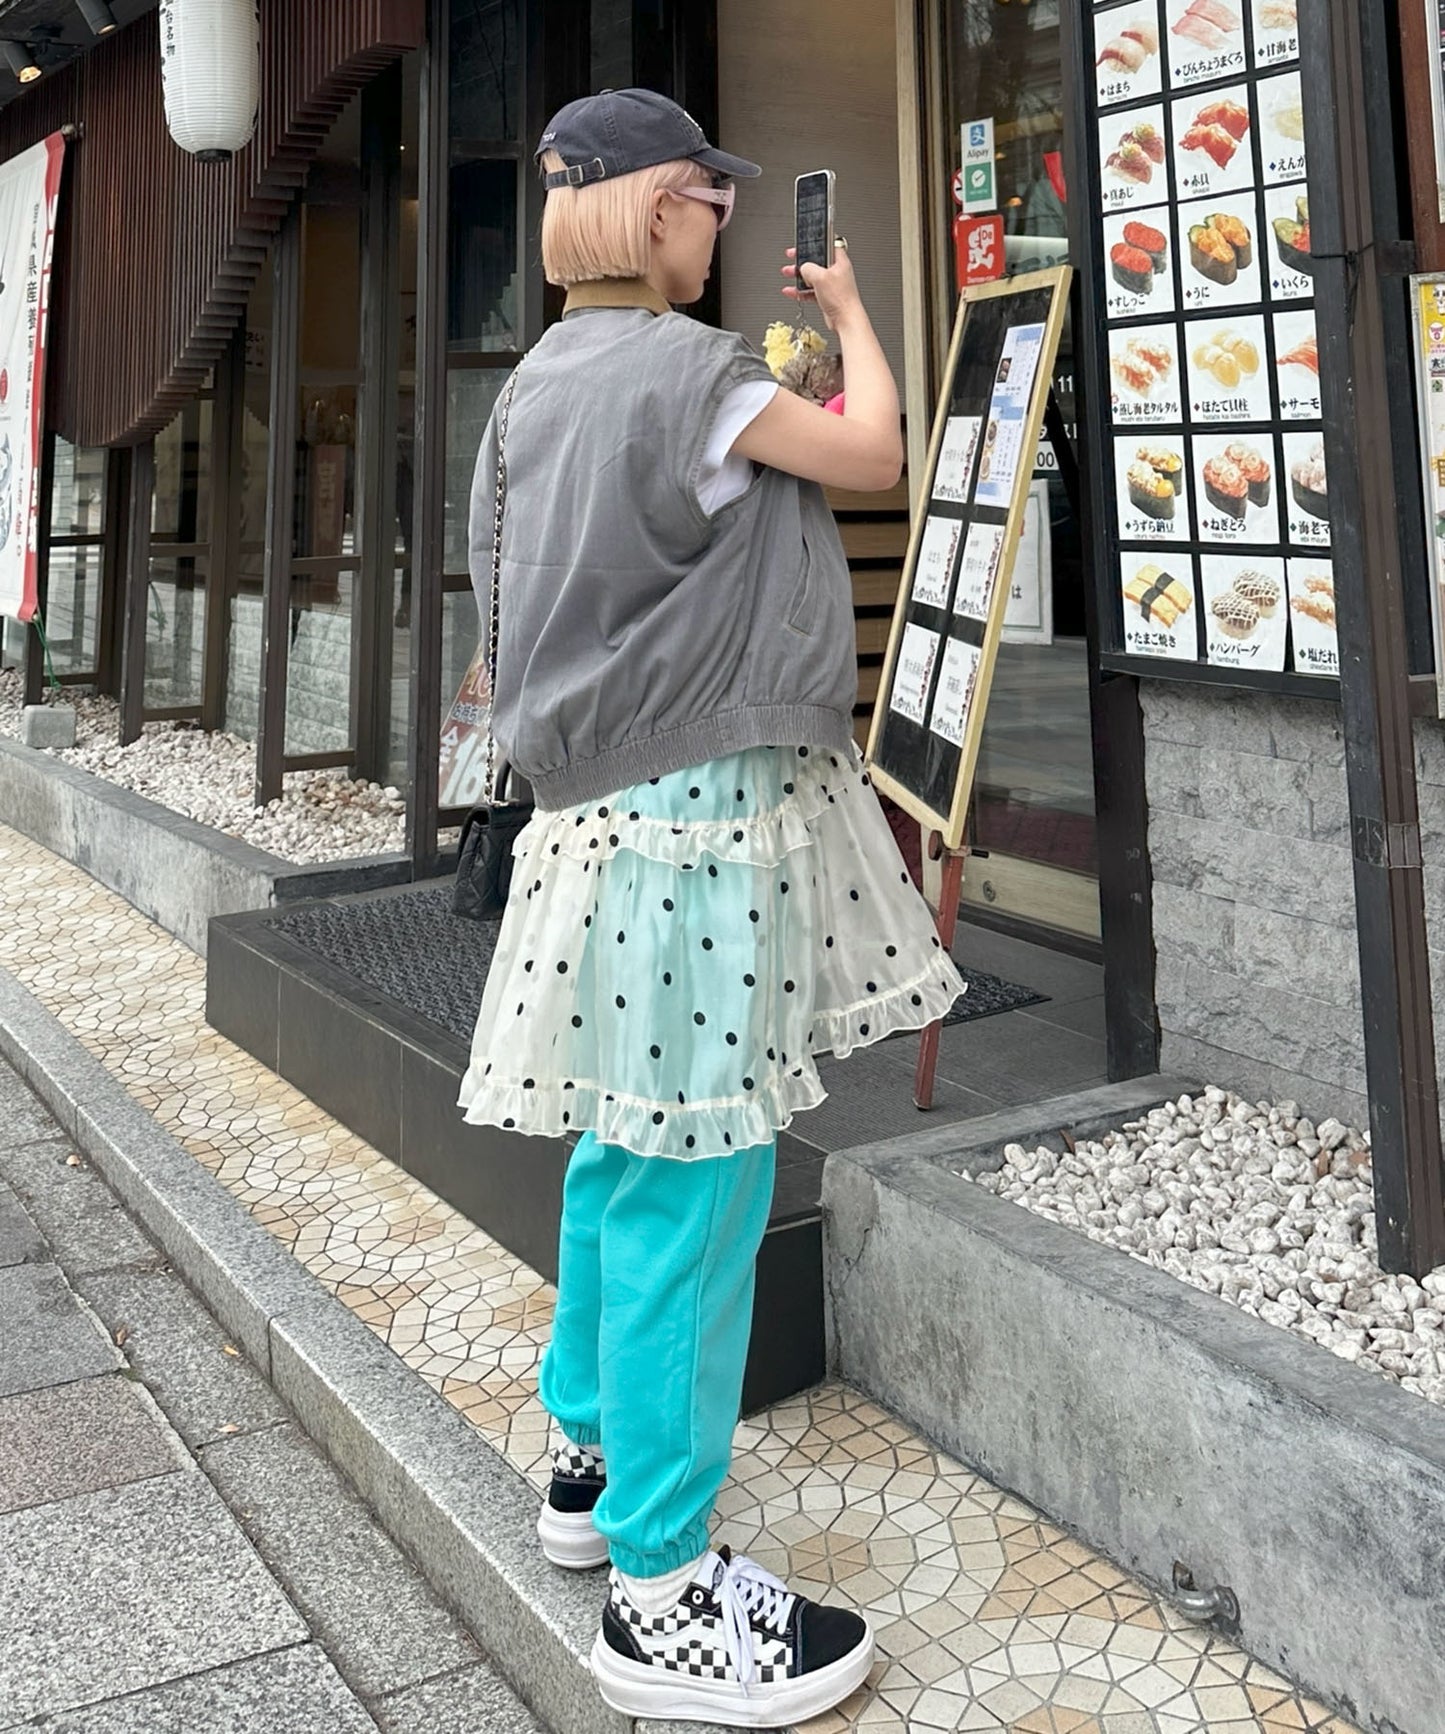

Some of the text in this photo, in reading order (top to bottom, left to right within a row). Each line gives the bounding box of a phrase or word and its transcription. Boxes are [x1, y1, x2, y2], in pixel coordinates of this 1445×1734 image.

[1266, 38, 1297, 57] 甘海老
[1106, 81, 1131, 97] はまち
[966, 149, 990, 160] Alipay
[1281, 275, 1309, 289] いくら
[1193, 286, 1210, 299] うに
[1119, 402, 1179, 417] 蒸し海老タルタル
[1201, 398, 1248, 413] ほたて貝柱
[1288, 397, 1320, 411] サーモ
[1132, 519, 1175, 534] うずら納豆
[1210, 518, 1247, 532] ねぎとろ
[1298, 520, 1331, 535] 海老マ
[1134, 631, 1176, 648] たまご焼き
[1216, 643, 1262, 658] ハンバーグ
[1307, 647, 1337, 664] 塩だれ
